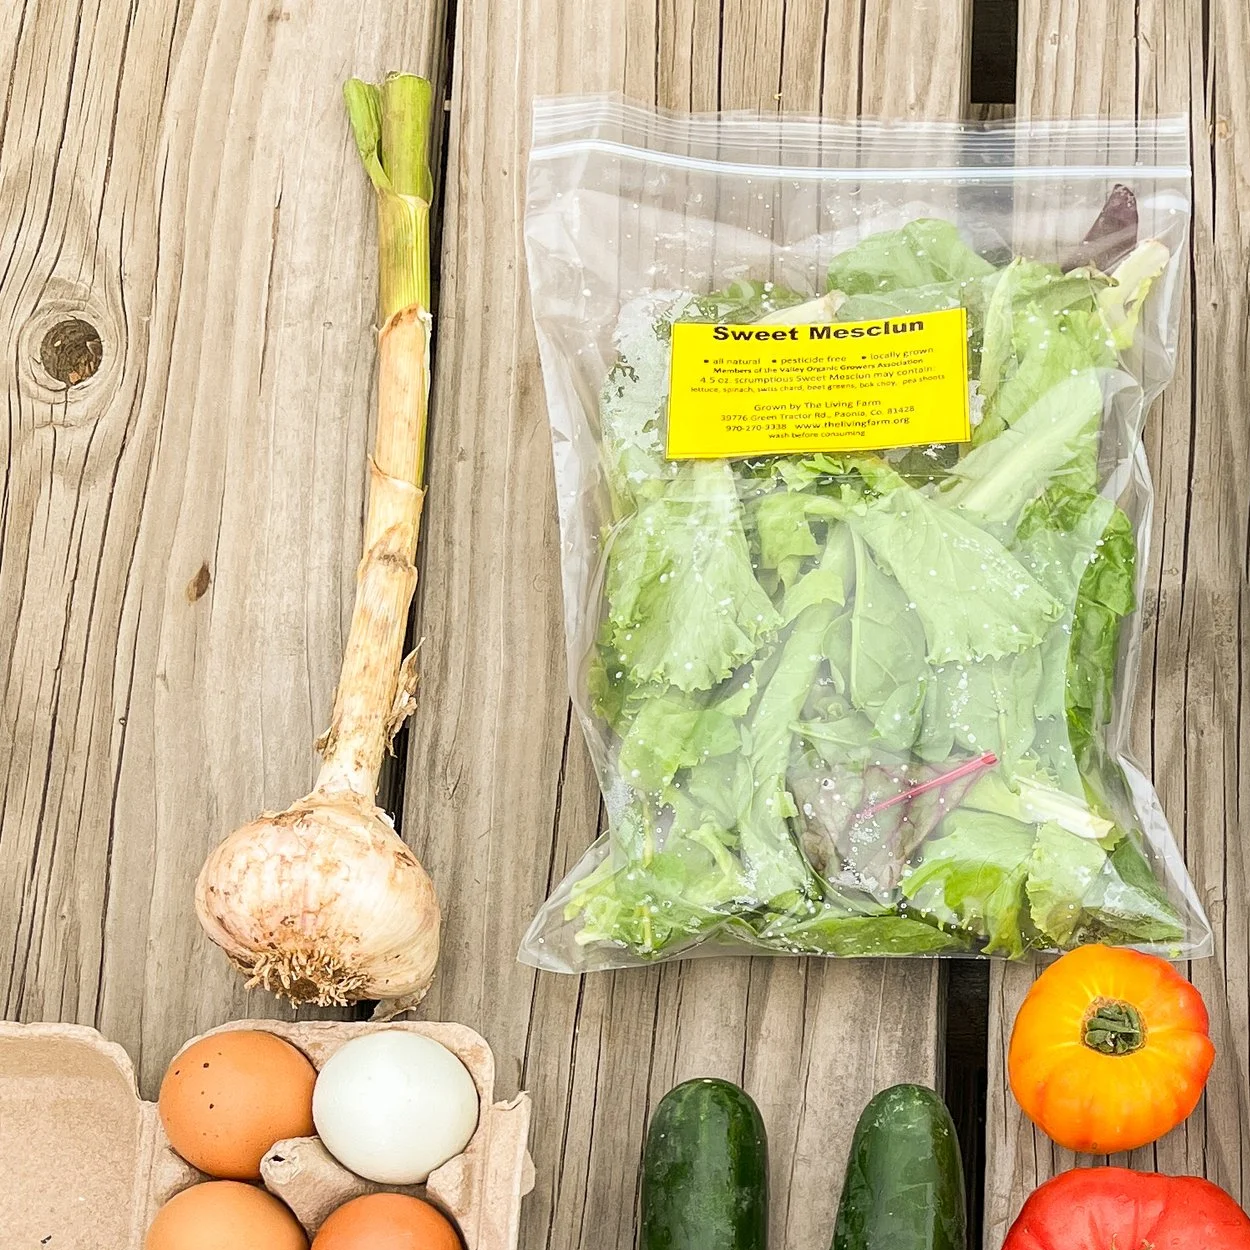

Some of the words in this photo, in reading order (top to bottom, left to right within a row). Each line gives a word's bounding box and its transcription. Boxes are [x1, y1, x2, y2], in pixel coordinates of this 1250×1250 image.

[713, 326, 799, 341] Sweet
[809, 321, 924, 340] Mesclun
[781, 357, 824, 365] pesticide
[827, 355, 847, 363] free
[870, 351, 900, 360] locally
[903, 347, 934, 358] grown
[840, 363, 875, 371] Growers
[877, 358, 923, 368] Association
[735, 376, 794, 384] scrumptious
[796, 374, 827, 382] Sweet
[829, 372, 871, 381] Mesclun
[873, 371, 894, 379] may
[827, 382, 857, 391] greens,
[919, 374, 945, 383] shoots
[754, 404, 787, 412] Grown
[789, 403, 801, 411] by
[824, 400, 854, 409] Living
[856, 399, 881, 407] Farm
[720, 414, 748, 422] 39776
[780, 412, 811, 421] Tractor
[834, 410, 868, 418] Paonia,
[795, 416, 910, 430] www.thelivingfarm.org
[791, 431, 818, 439] before
[820, 430, 866, 439] consuming
